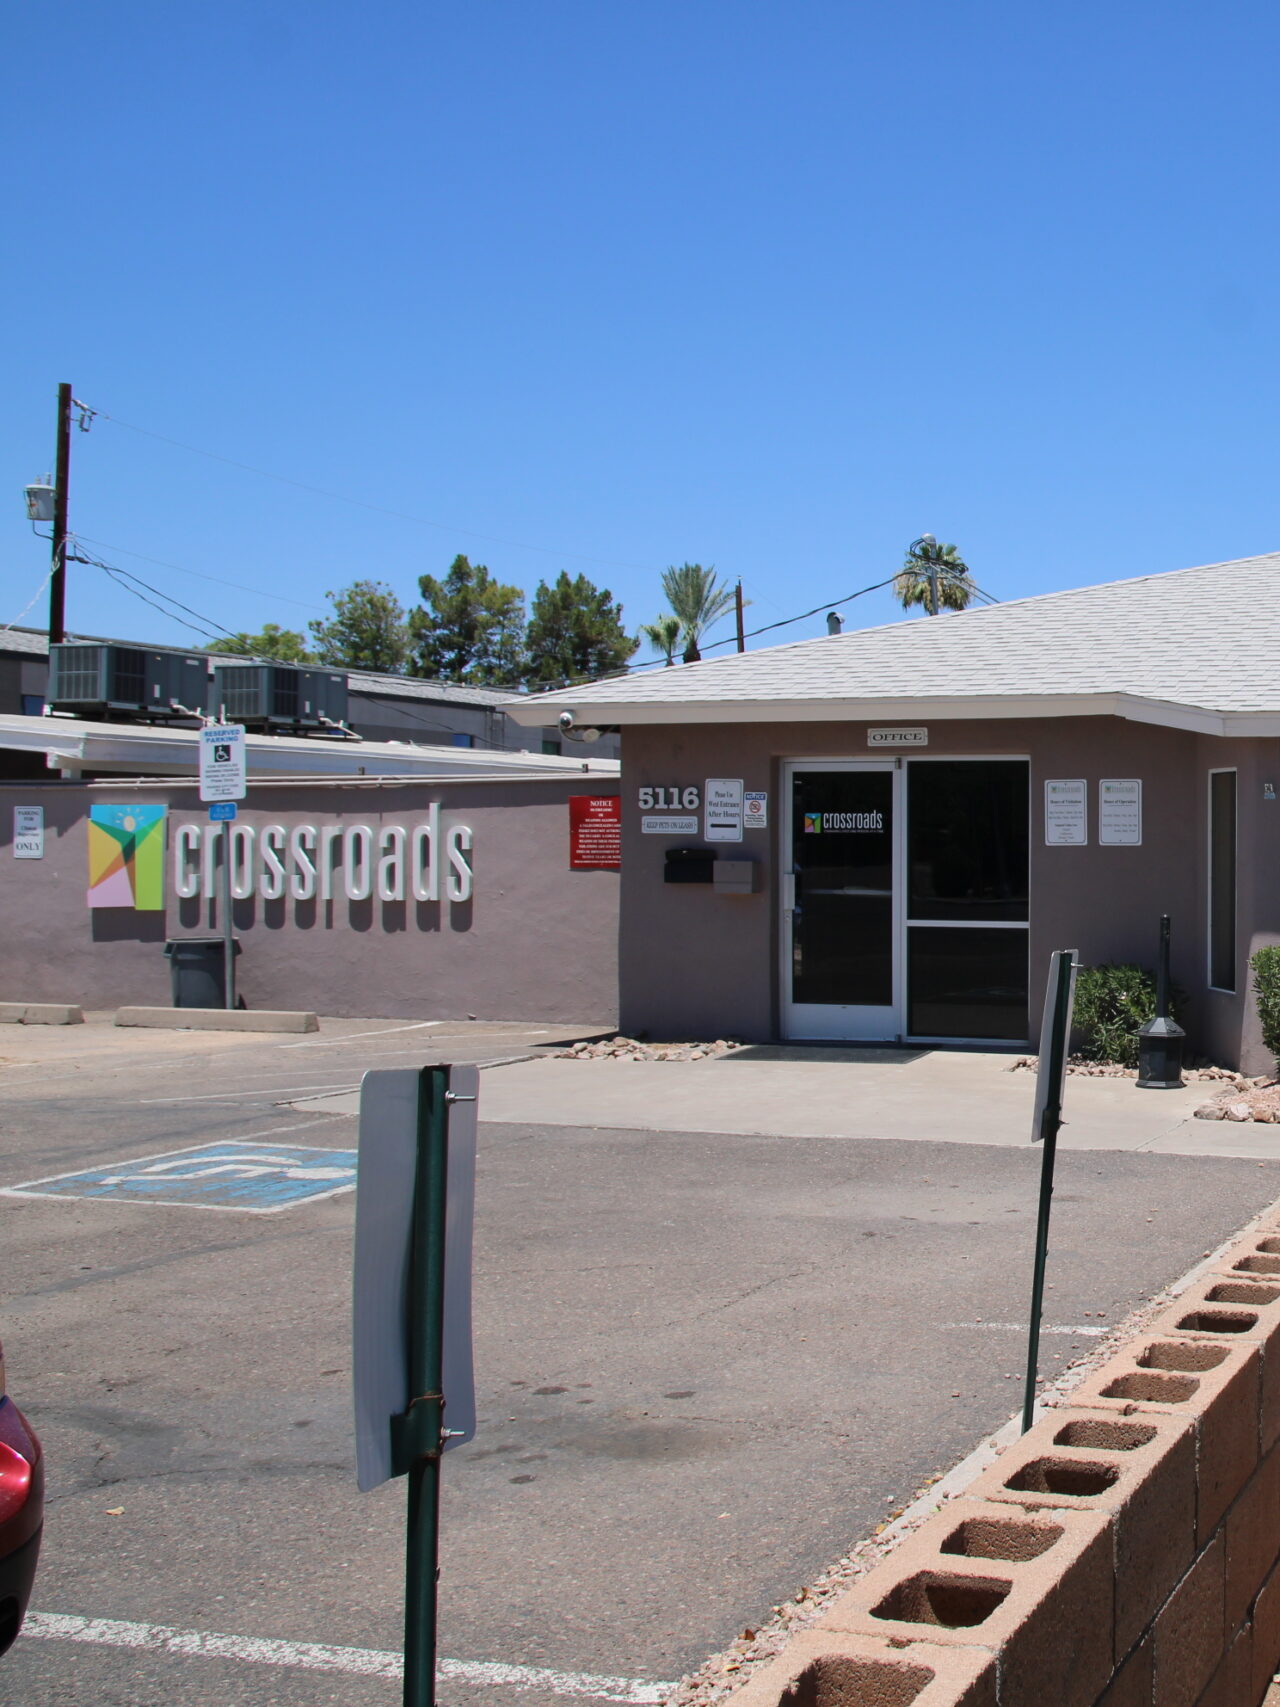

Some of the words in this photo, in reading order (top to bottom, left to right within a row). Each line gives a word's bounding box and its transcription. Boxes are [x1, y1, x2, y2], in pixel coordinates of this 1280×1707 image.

[204, 729, 240, 737] RESERVED
[872, 733, 922, 741] OFFICE
[638, 787, 700, 809] 5116
[823, 809, 883, 829] crossroads
[16, 842, 41, 851] ONLY
[175, 803, 473, 902] crossroads
